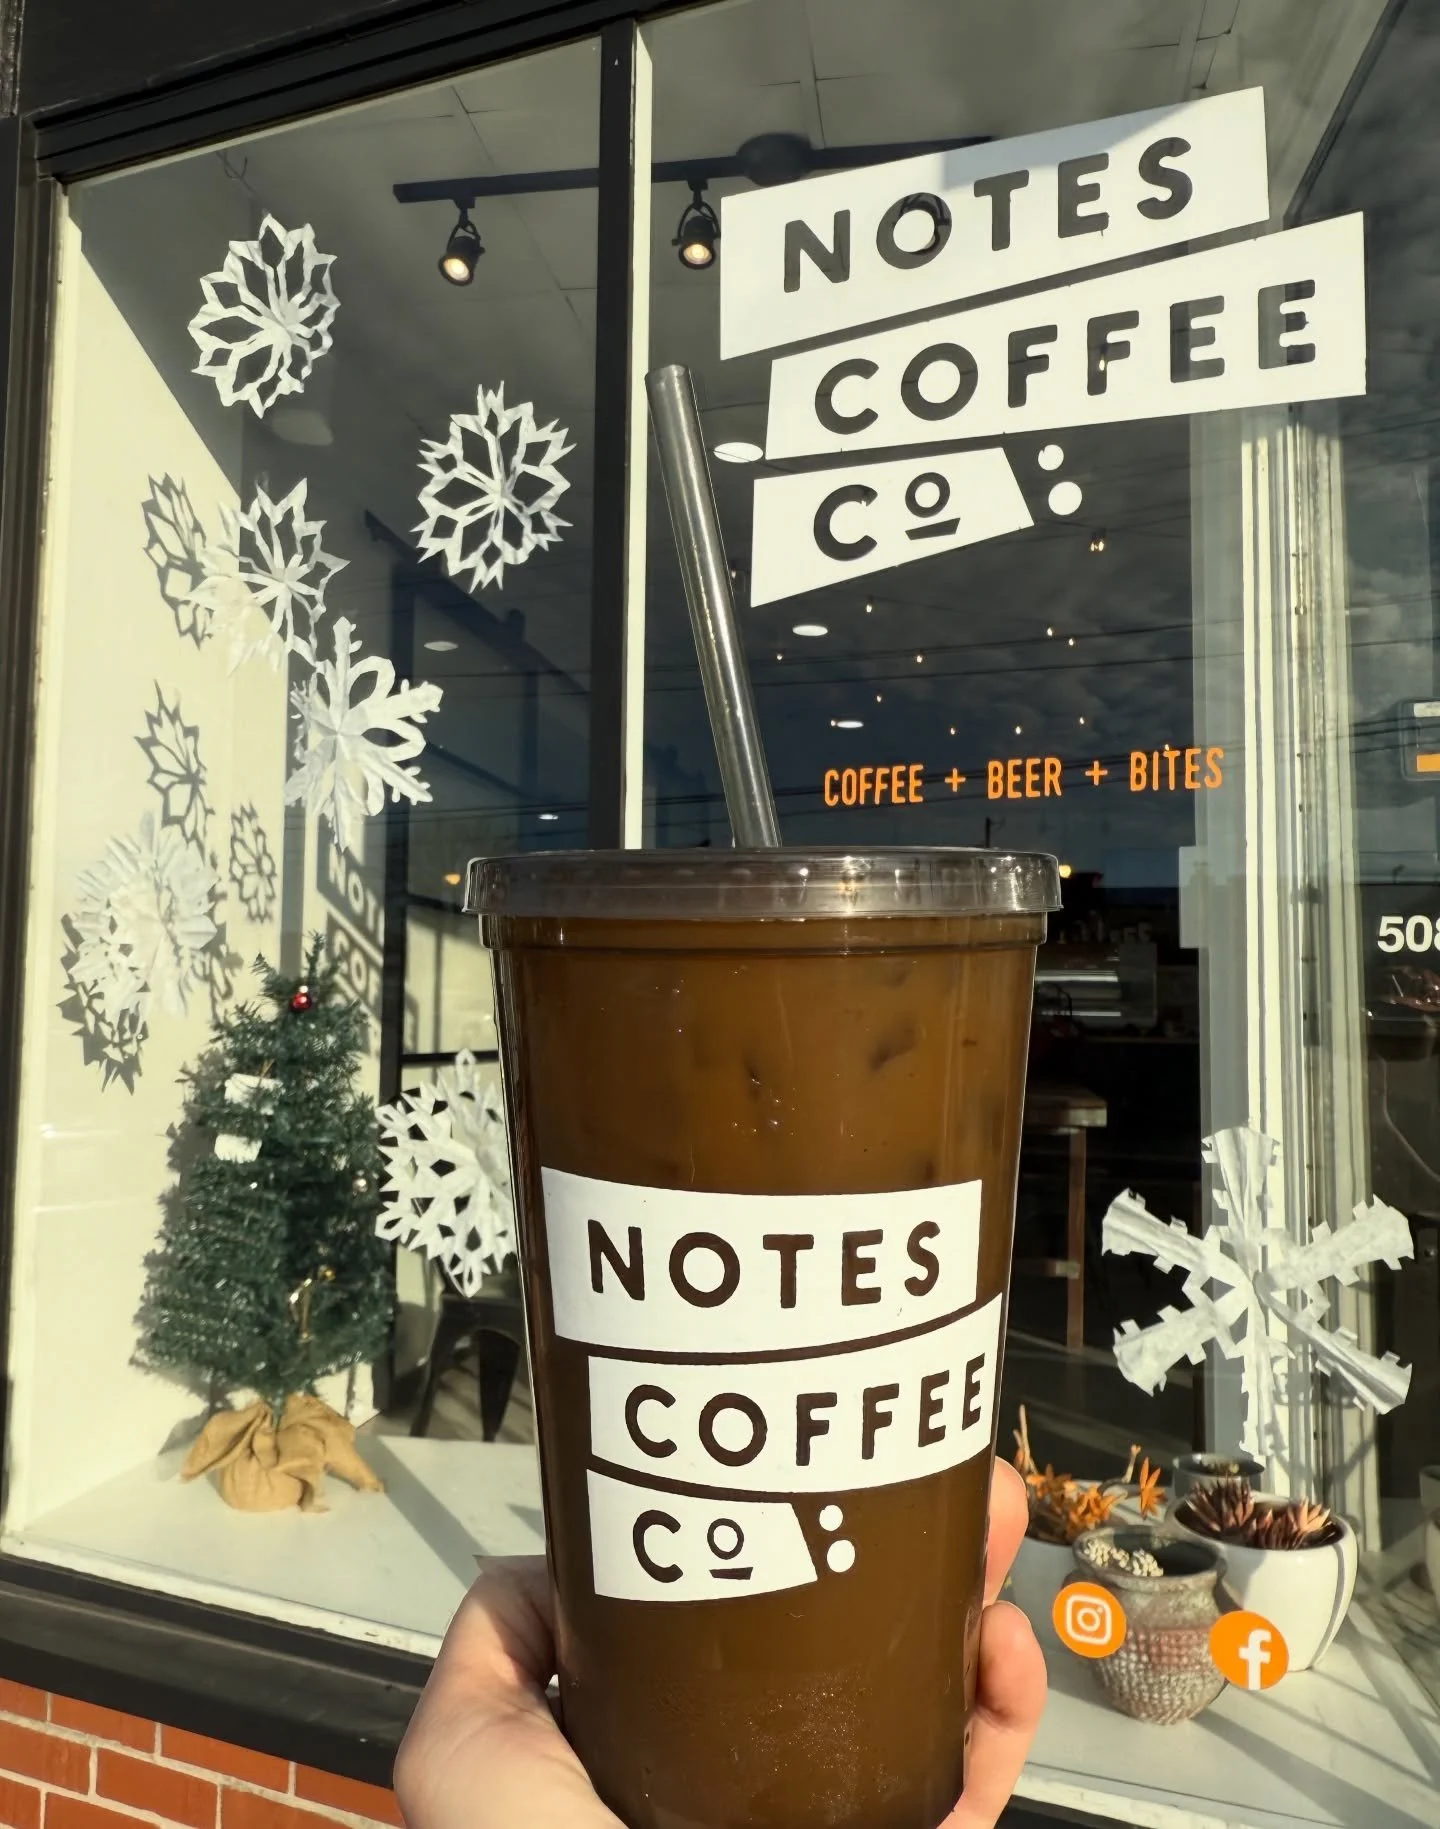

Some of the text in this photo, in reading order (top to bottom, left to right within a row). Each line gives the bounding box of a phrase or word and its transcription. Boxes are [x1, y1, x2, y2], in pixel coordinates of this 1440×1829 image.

[784, 136, 1193, 293] NOTES
[814, 279, 1316, 435] COFFEE
[823, 764, 924, 807] COFFEE
[986, 757, 1063, 800] BEER
[1129, 747, 1225, 792] BITES
[1377, 914, 1440, 953] 50
[587, 1219, 941, 1309] NOTES
[624, 1352, 986, 1467] COFFEE
